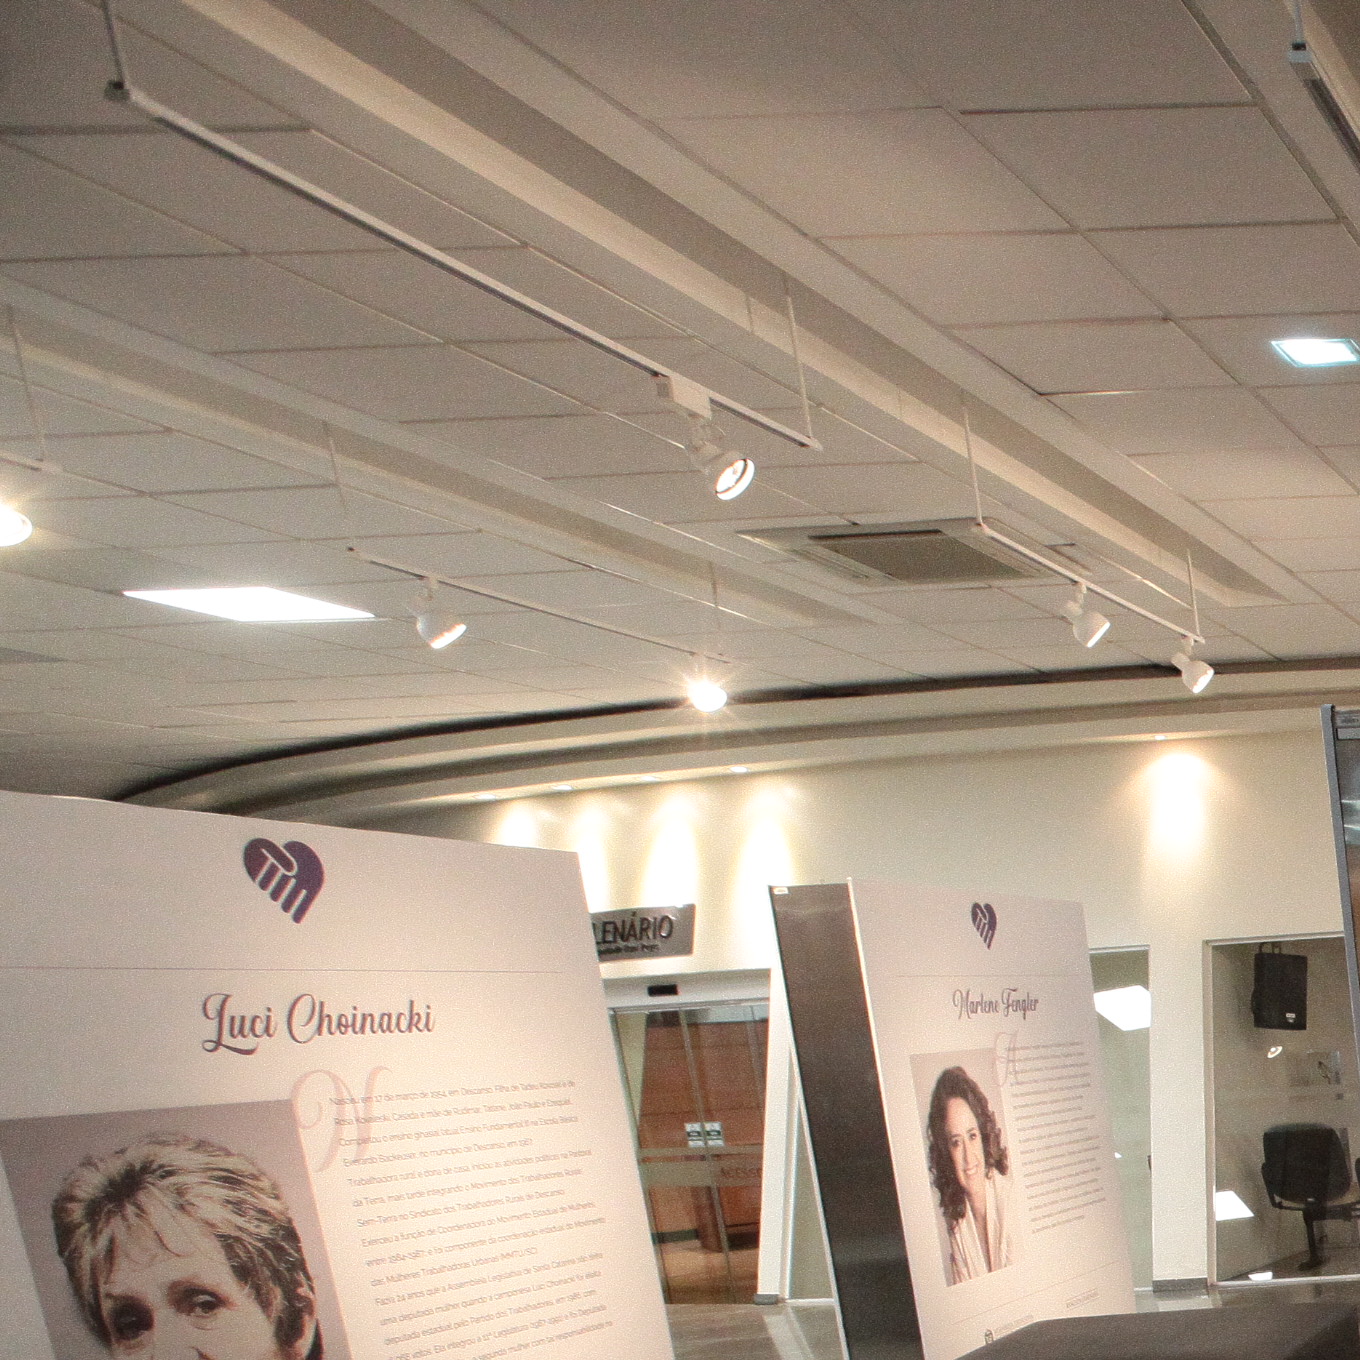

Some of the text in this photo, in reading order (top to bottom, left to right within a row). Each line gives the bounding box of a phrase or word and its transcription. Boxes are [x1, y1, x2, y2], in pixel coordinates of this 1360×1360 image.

[592, 911, 673, 944] LENÁRIO
[952, 987, 1039, 1020] Marlene Fengler
[202, 993, 436, 1055] Luci Choinacki
